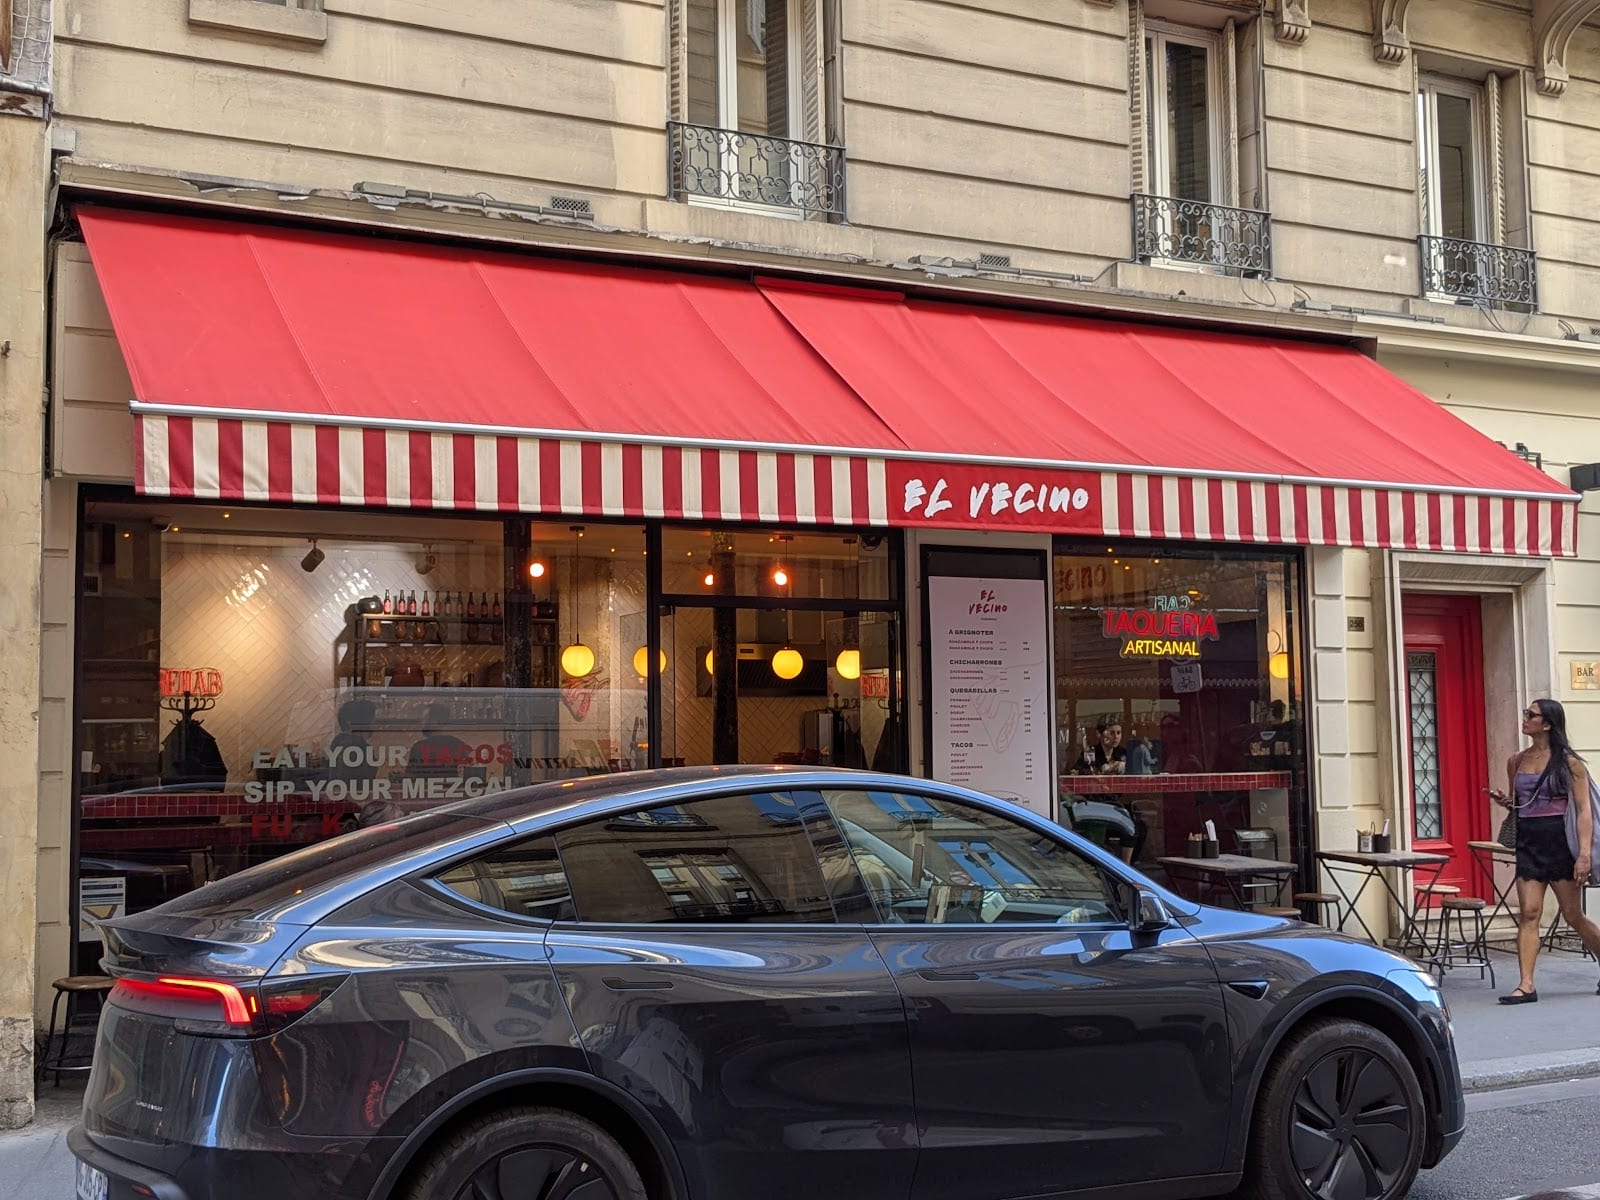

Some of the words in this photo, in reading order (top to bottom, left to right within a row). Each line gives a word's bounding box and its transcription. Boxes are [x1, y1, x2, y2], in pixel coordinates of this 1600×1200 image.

[904, 478, 952, 518] EL
[969, 482, 1089, 518] VECINO
[980, 590, 995, 602] EL
[968, 603, 1008, 615] VECINO
[1103, 610, 1218, 637] TAQUERIA
[1124, 640, 1200, 656] ARTISANAL
[1576, 667, 1594, 677] BAR
[253, 746, 312, 769] EAT
[324, 745, 408, 768] YOUR
[417, 743, 513, 766] TACOS
[245, 780, 295, 803] SIP
[305, 779, 392, 802] YOUR
